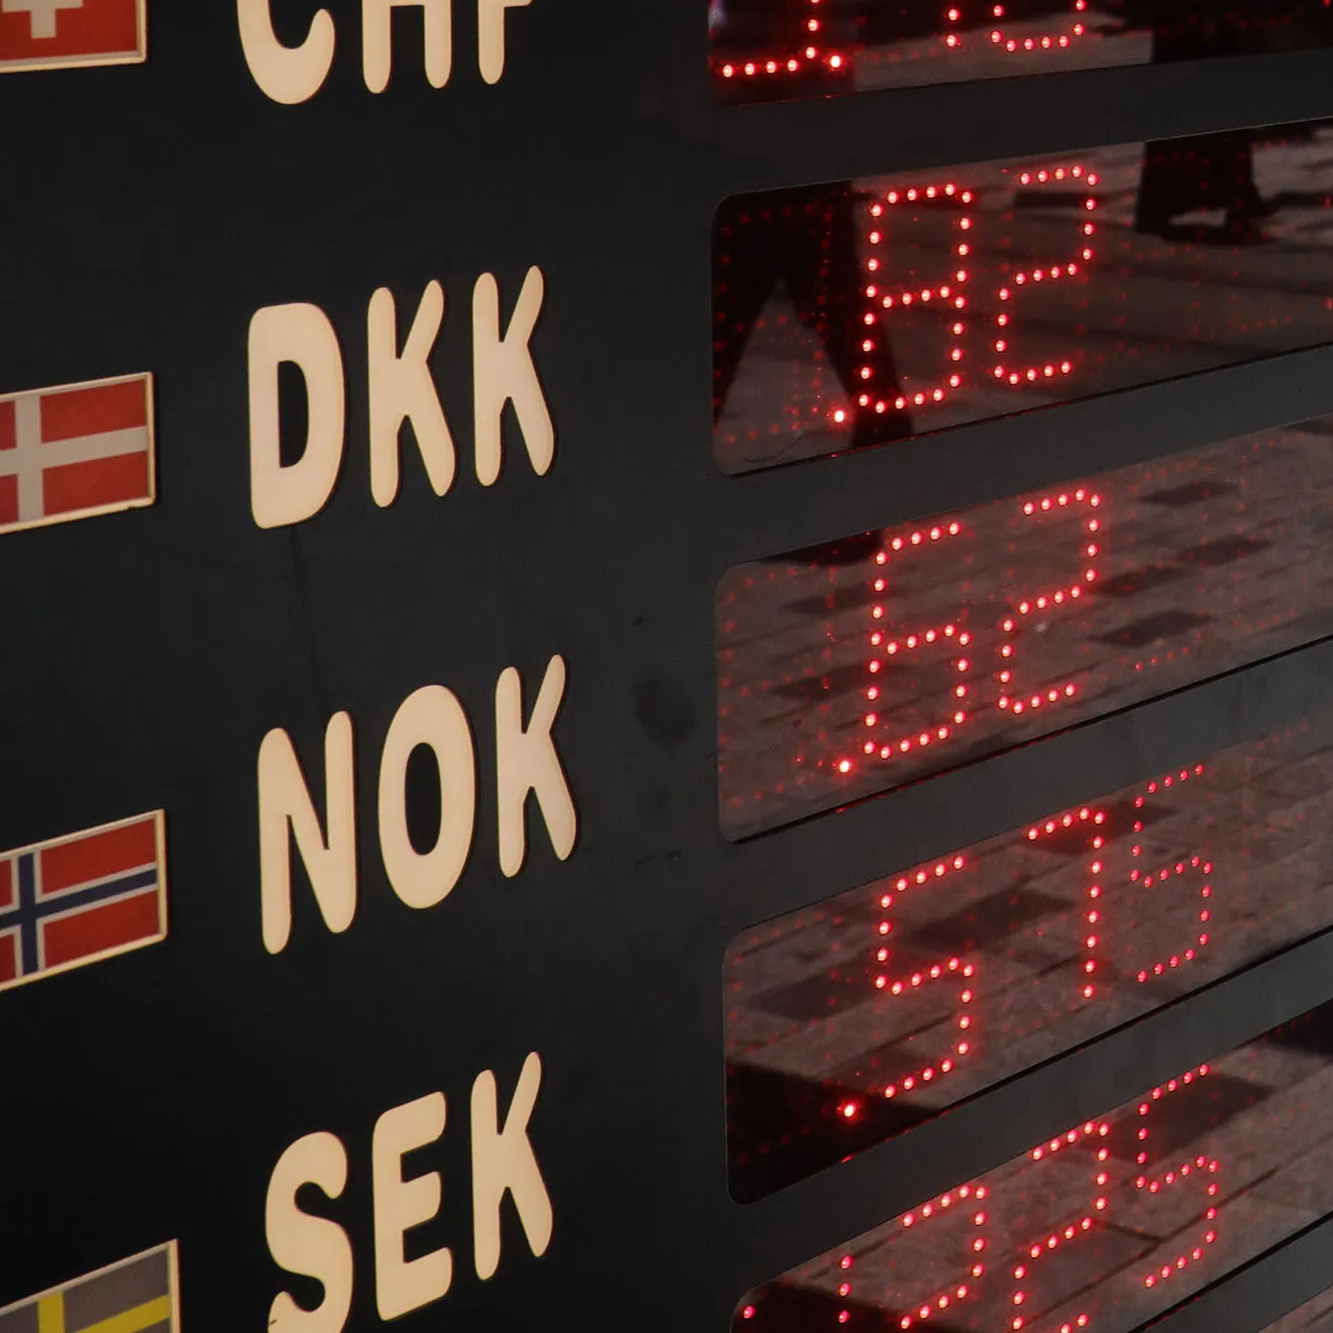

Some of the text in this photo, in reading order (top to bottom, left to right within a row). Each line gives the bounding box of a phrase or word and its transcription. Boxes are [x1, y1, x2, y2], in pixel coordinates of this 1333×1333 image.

[247, 265, 555, 529] DKK
[257, 654, 577, 955] NOK
[264, 1051, 554, 1333] SEK
